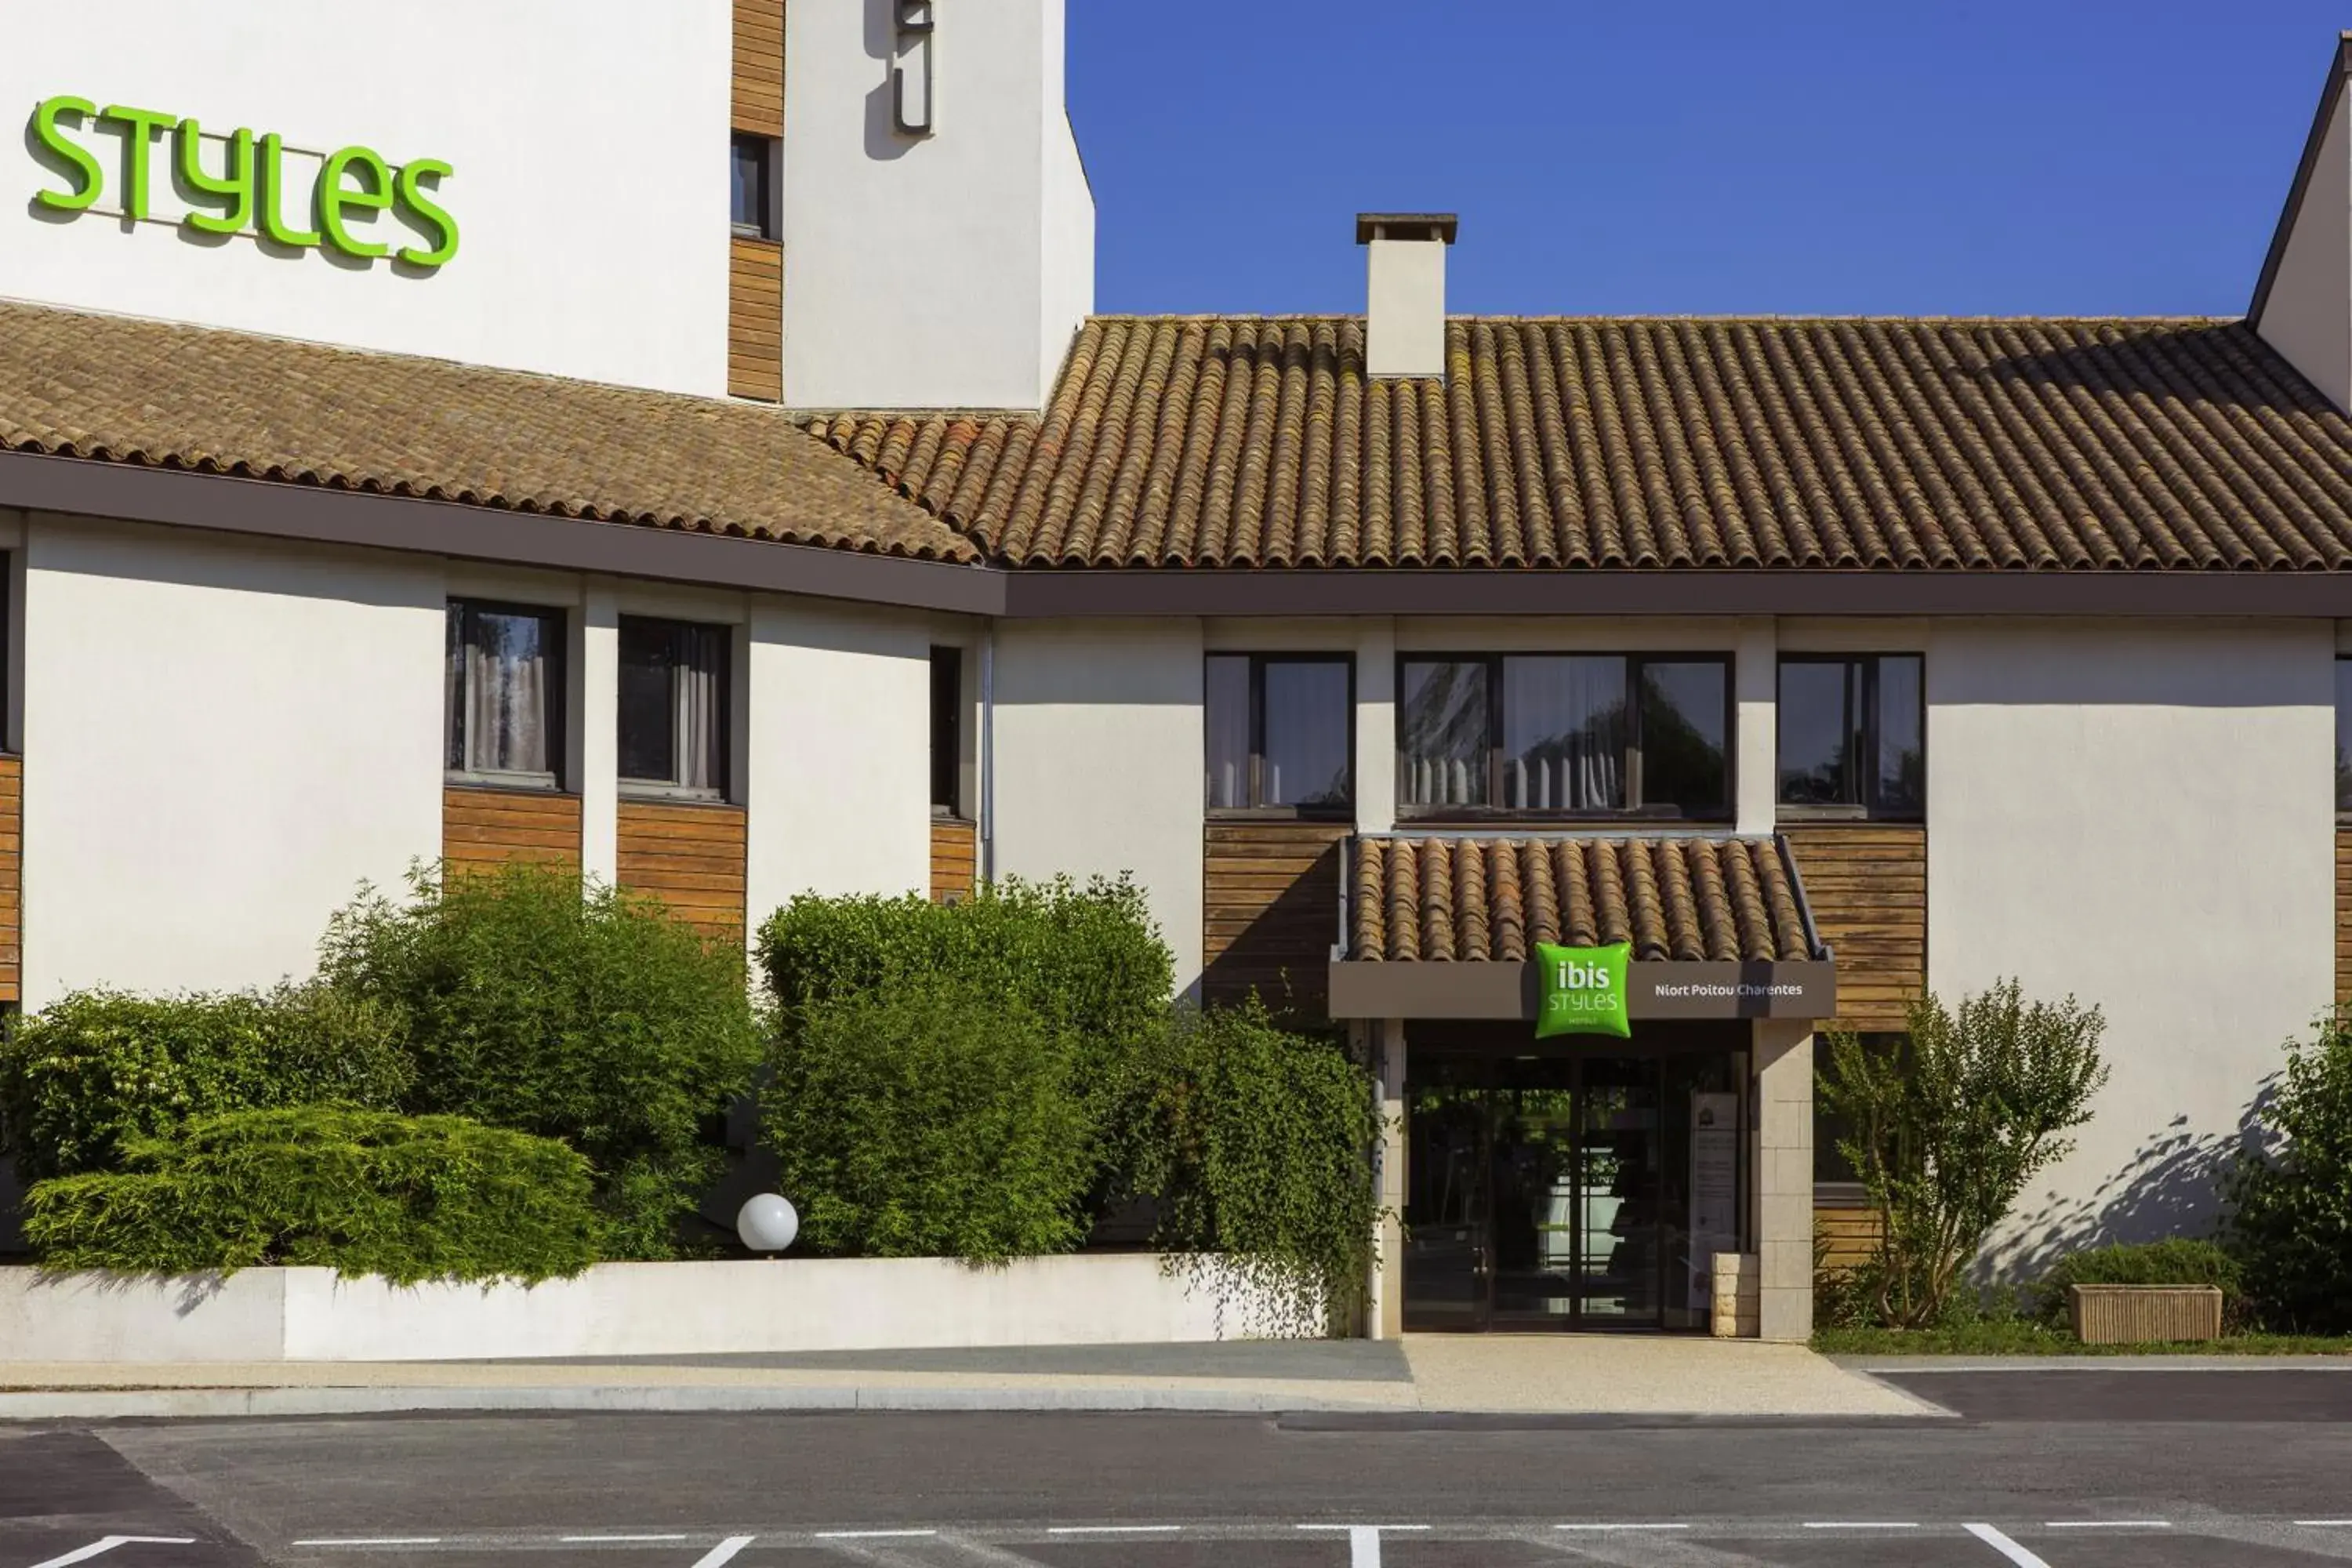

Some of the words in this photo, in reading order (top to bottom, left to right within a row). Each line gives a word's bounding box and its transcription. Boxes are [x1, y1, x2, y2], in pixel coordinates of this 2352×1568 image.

[1559, 960, 1610, 989] ibis
[1655, 984, 1689, 996] Niort
[1691, 984, 1734, 996] Poitou
[1737, 983, 1803, 996] Charentes
